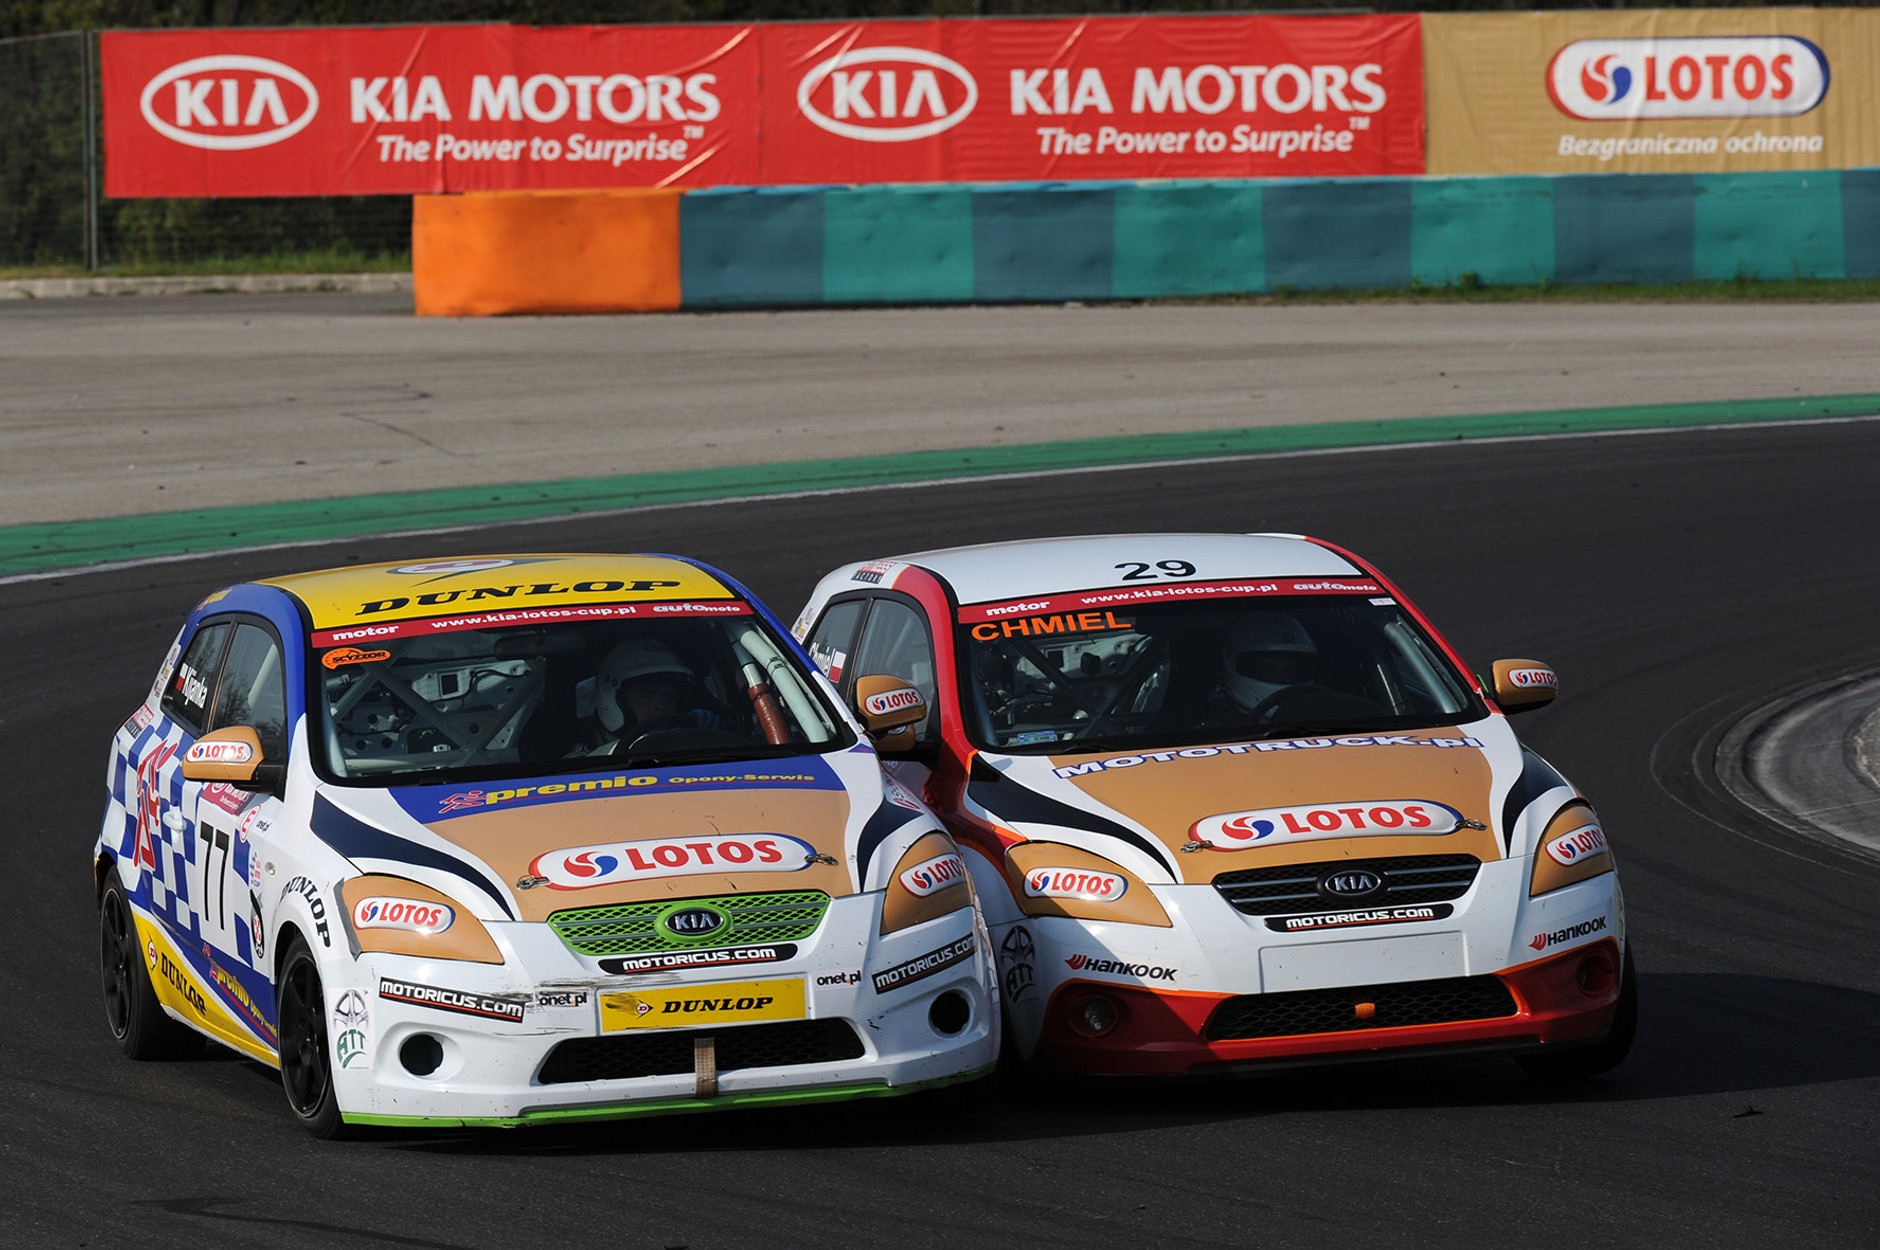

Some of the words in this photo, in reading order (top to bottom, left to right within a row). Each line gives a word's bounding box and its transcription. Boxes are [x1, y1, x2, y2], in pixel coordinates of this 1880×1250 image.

[1010, 68, 1113, 115] KIA
[1131, 63, 1386, 114] MOTORS
[1645, 54, 1793, 101] LOTOS
[174, 79, 290, 126] KIA
[350, 77, 452, 122] KIA
[468, 73, 720, 122] MOTORS
[832, 69, 948, 119] KIA
[377, 135, 431, 162] The
[435, 136, 524, 162] Power
[529, 139, 559, 160] to
[565, 134, 688, 167] Surprise
[1037, 128, 1092, 155] The
[1096, 126, 1188, 155] Power
[1195, 129, 1225, 153] to
[1231, 124, 1353, 158] Surprise
[1558, 133, 1717, 160] Bezgraniczna
[1725, 131, 1823, 154] ochrona
[1115, 560, 1197, 581] 29
[355, 580, 680, 616] DUNLOP
[1081, 582, 1278, 605] www.kia-lotos-cup.pl
[431, 606, 636, 629] www.kia-lotos-cup.pl
[986, 600, 1050, 616] motor
[333, 625, 399, 641] motor
[971, 611, 1133, 641] CHMIEL
[886, 691, 919, 709] LOTOS
[205, 744, 244, 758] LOTOS
[485, 776, 658, 804] premio
[669, 774, 815, 784] Opony-Serwis
[1281, 806, 1432, 834] LOTOS
[625, 840, 782, 870] LOTOS
[200, 821, 229, 931] 77
[1051, 872, 1114, 895] LOTOS
[1334, 874, 1374, 890] KIA
[280, 876, 331, 947] DUNLOP
[380, 902, 441, 927] LOTOS
[675, 914, 723, 931] KIA
[1286, 907, 1434, 930] MOTORICUS.COM
[623, 949, 776, 971] MOTORICUS.COM
[161, 952, 206, 1016] DUNLOP
[817, 970, 861, 986] onet.pl
[381, 980, 523, 1018] MOTORICUS.COM
[539, 992, 587, 1007] onet.pl
[662, 997, 773, 1013] DUNLOP
